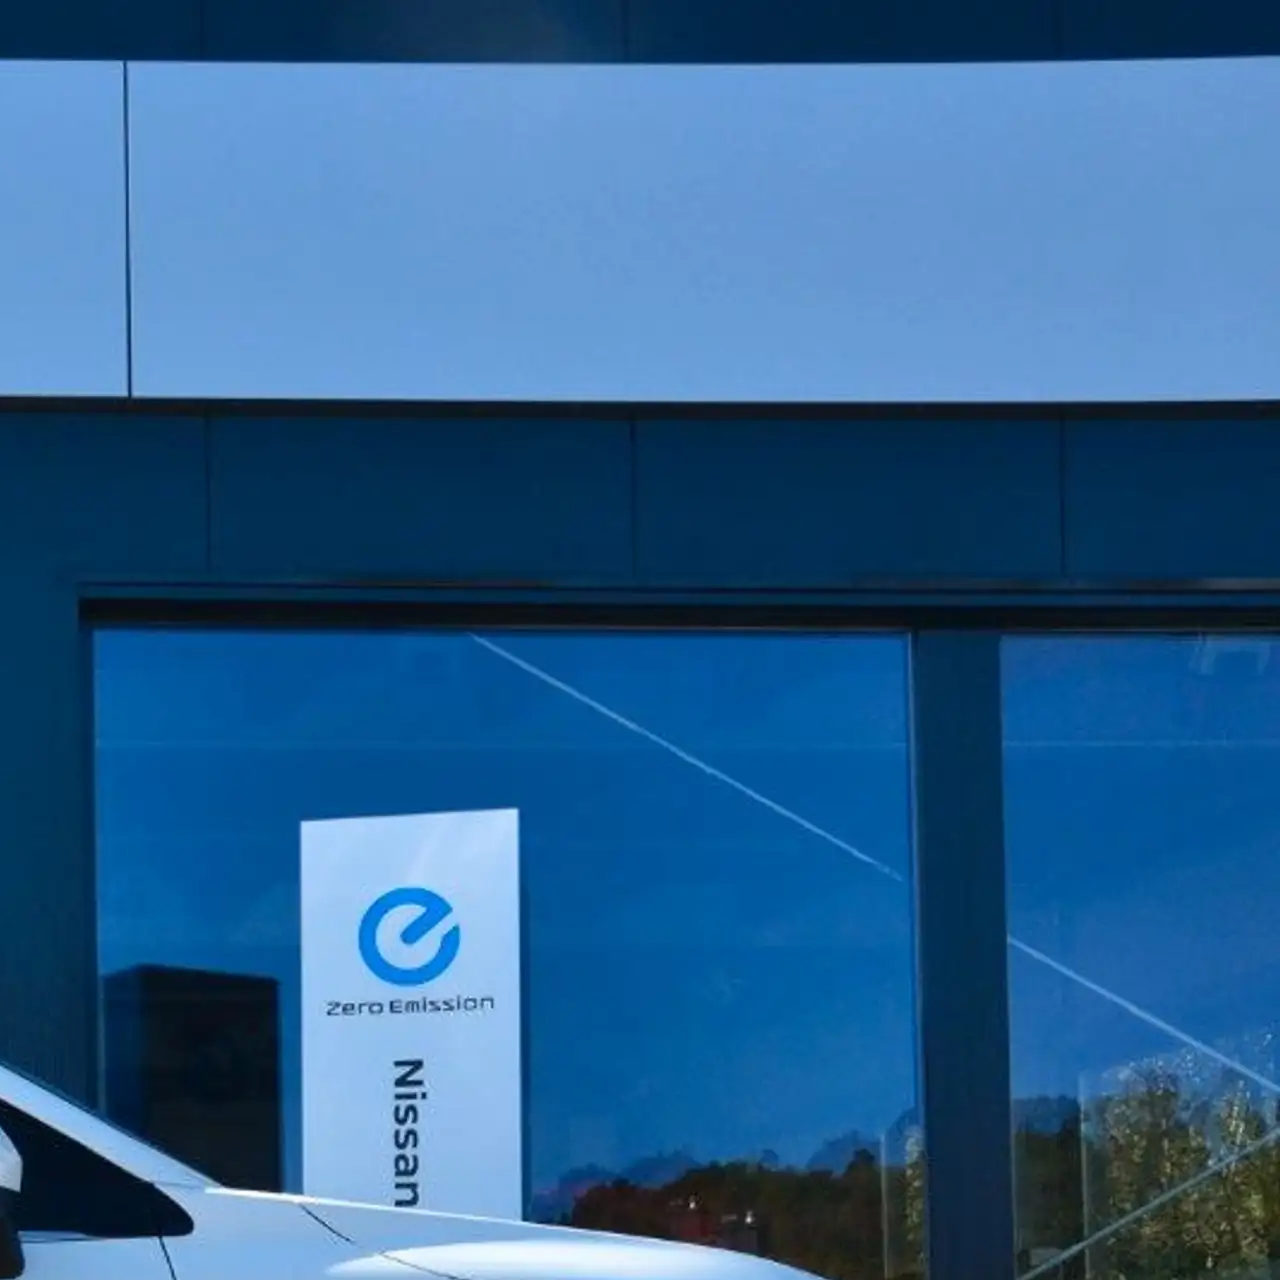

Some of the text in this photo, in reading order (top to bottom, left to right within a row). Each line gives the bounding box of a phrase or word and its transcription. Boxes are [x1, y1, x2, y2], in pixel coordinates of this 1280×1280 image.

[325, 994, 495, 1017] Zero Emission
[392, 1058, 428, 1208] Nissan
